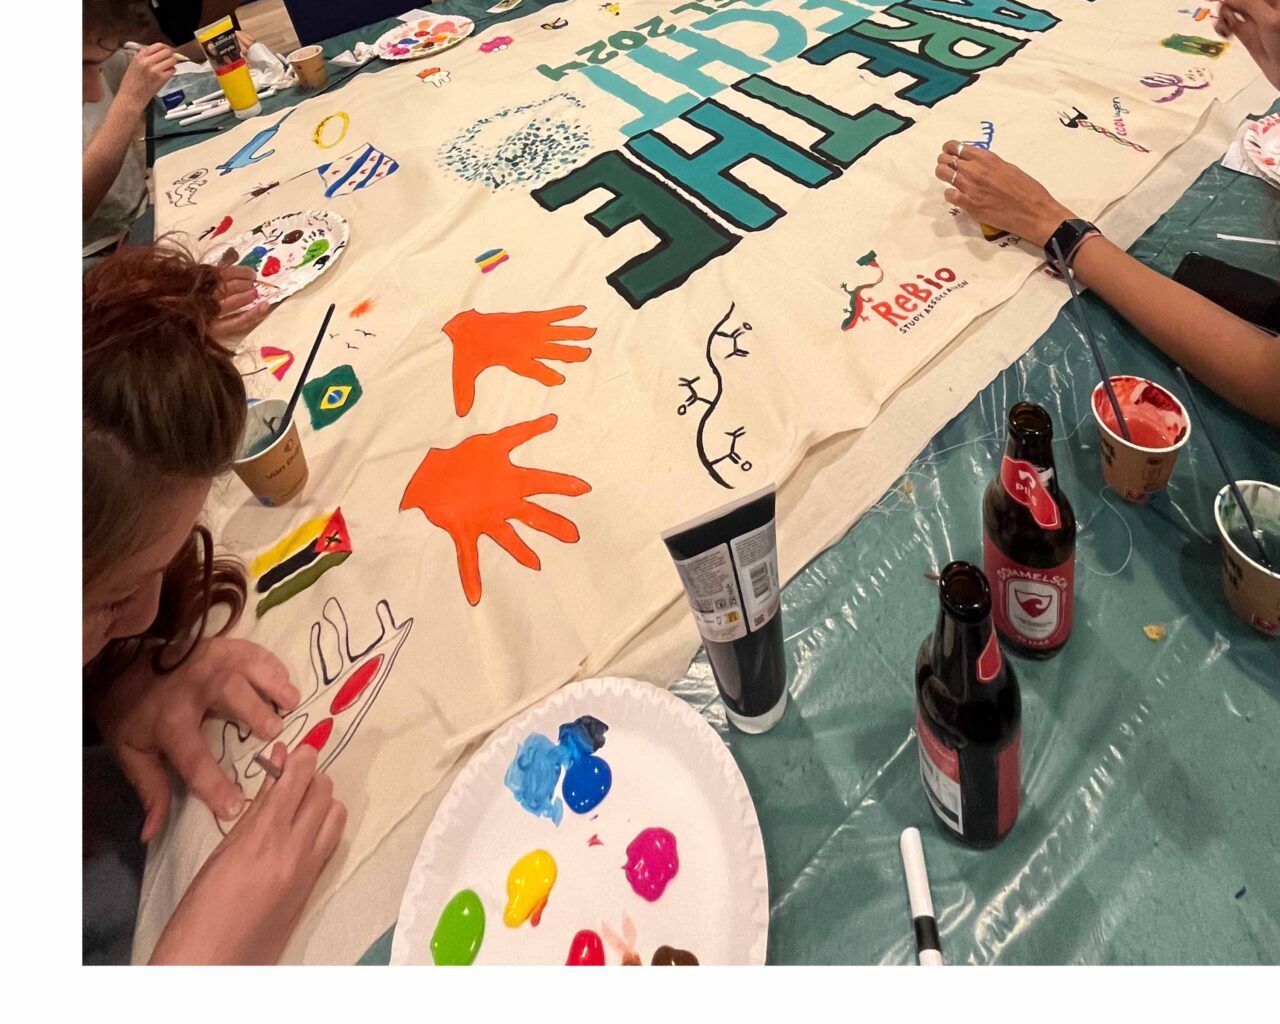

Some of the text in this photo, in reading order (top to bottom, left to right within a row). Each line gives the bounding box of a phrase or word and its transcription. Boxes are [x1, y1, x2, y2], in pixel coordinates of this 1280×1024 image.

[535, 15, 678, 83] 2024
[530, 73, 916, 310] THE
[871, 267, 957, 327] ReBio
[899, 280, 969, 334] STUDY ASSOCIATION
